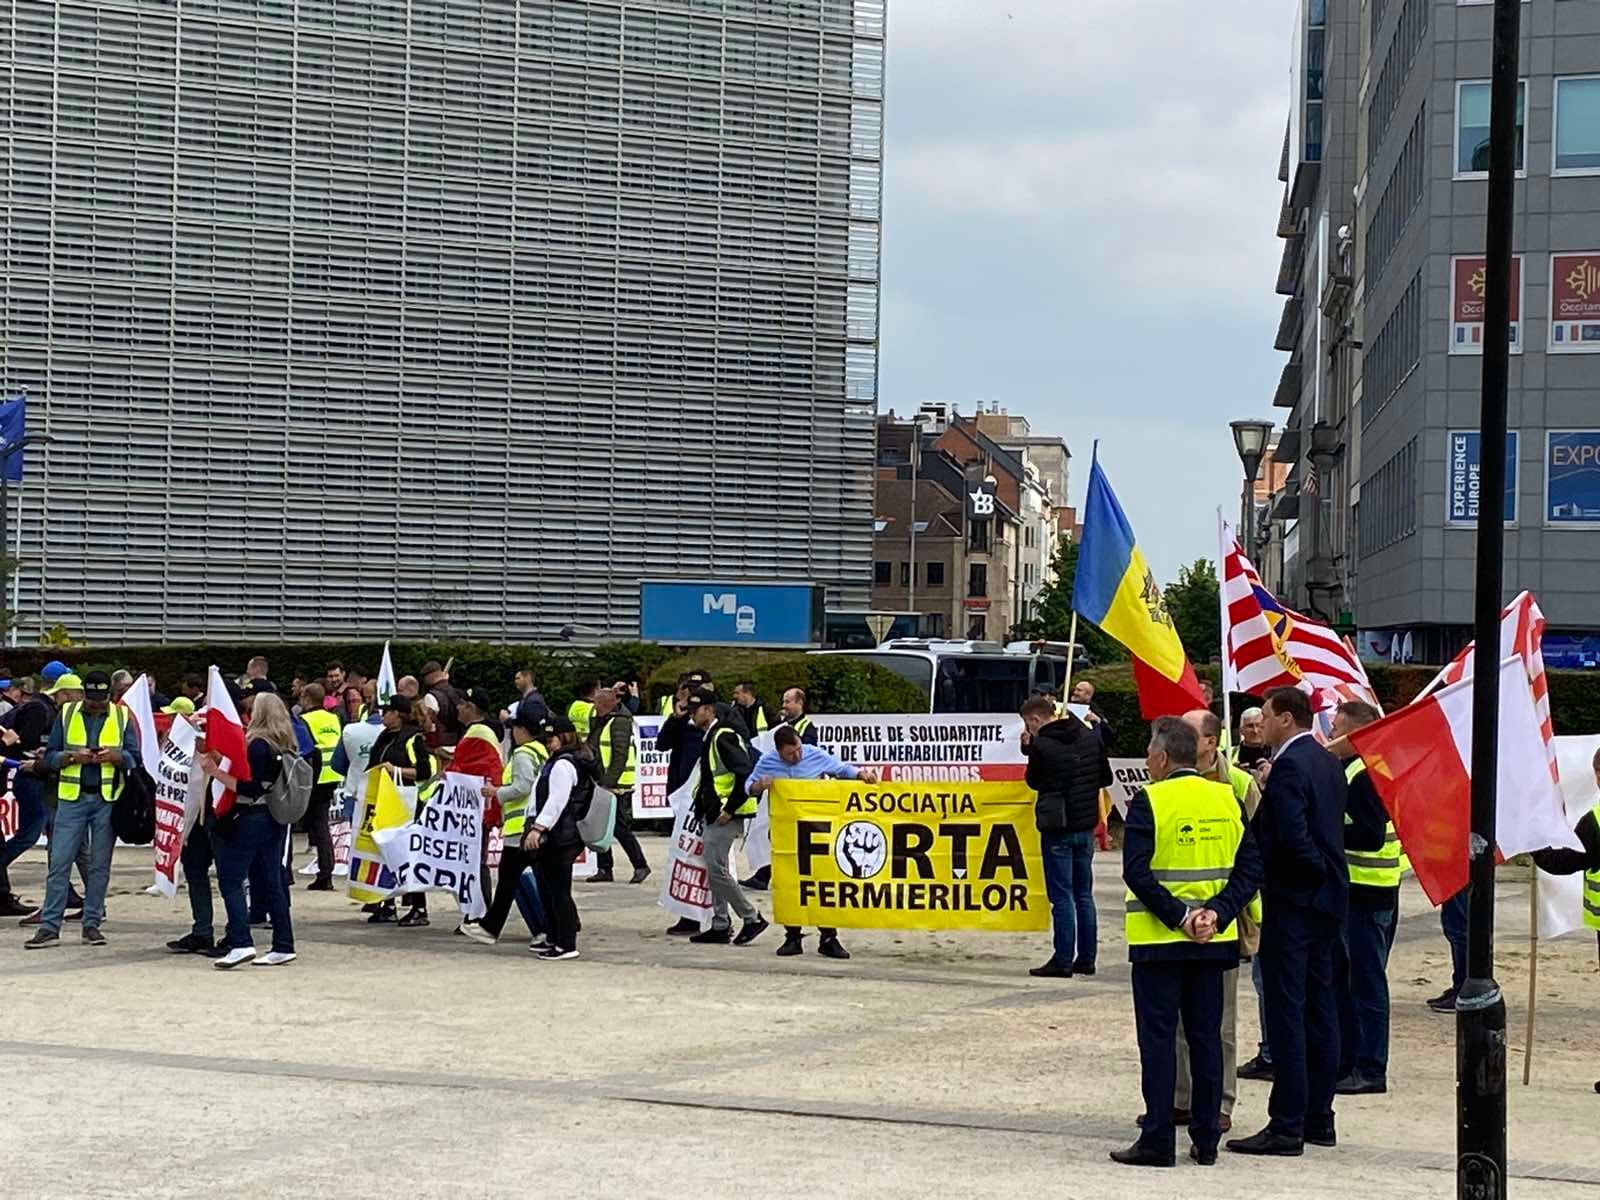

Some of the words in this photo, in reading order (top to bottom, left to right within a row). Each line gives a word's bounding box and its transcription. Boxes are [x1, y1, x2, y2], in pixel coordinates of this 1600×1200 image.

[1462, 303, 1484, 314] Occi
[1560, 302, 1600, 312] Occitan
[1454, 436, 1466, 516] EXPERIENCE
[1469, 463, 1480, 516] EUROPE
[703, 593, 736, 614] M
[817, 726, 882, 743] IDOARELE
[888, 726, 904, 743] DE
[910, 725, 1005, 744] SOLIDARITATE,
[641, 741, 657, 751] RO
[841, 745, 858, 762] DE
[864, 745, 983, 762] VULNERABILITATE!
[641, 753, 663, 764] LOST
[683, 814, 704, 837] LOS
[800, 880, 1028, 912] FERMIERILOR
